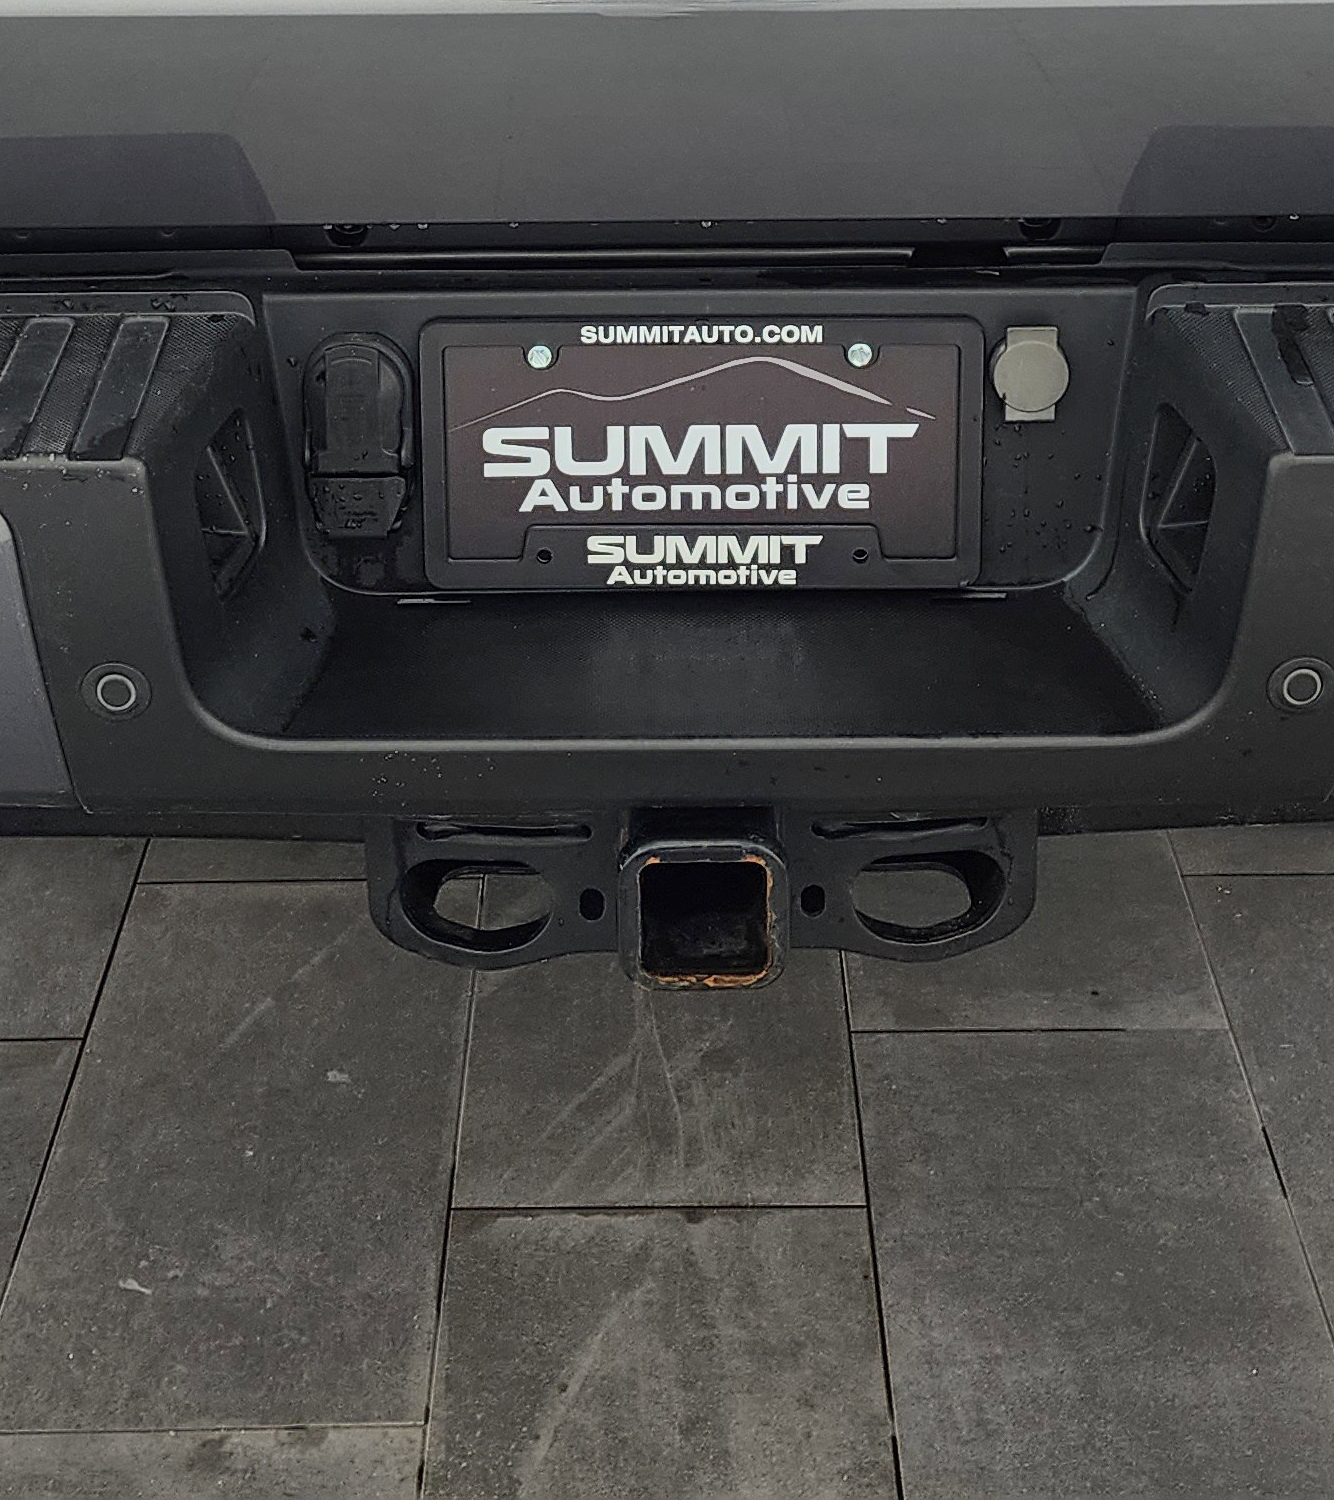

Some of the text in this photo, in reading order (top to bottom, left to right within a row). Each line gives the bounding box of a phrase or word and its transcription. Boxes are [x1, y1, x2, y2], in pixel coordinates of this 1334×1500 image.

[579, 324, 824, 345] SUMMITAUTO.COM
[482, 422, 920, 478] SUMMIT
[518, 474, 871, 513] Automotive
[586, 534, 824, 565] SUMMIT
[606, 565, 798, 586] Automotive
